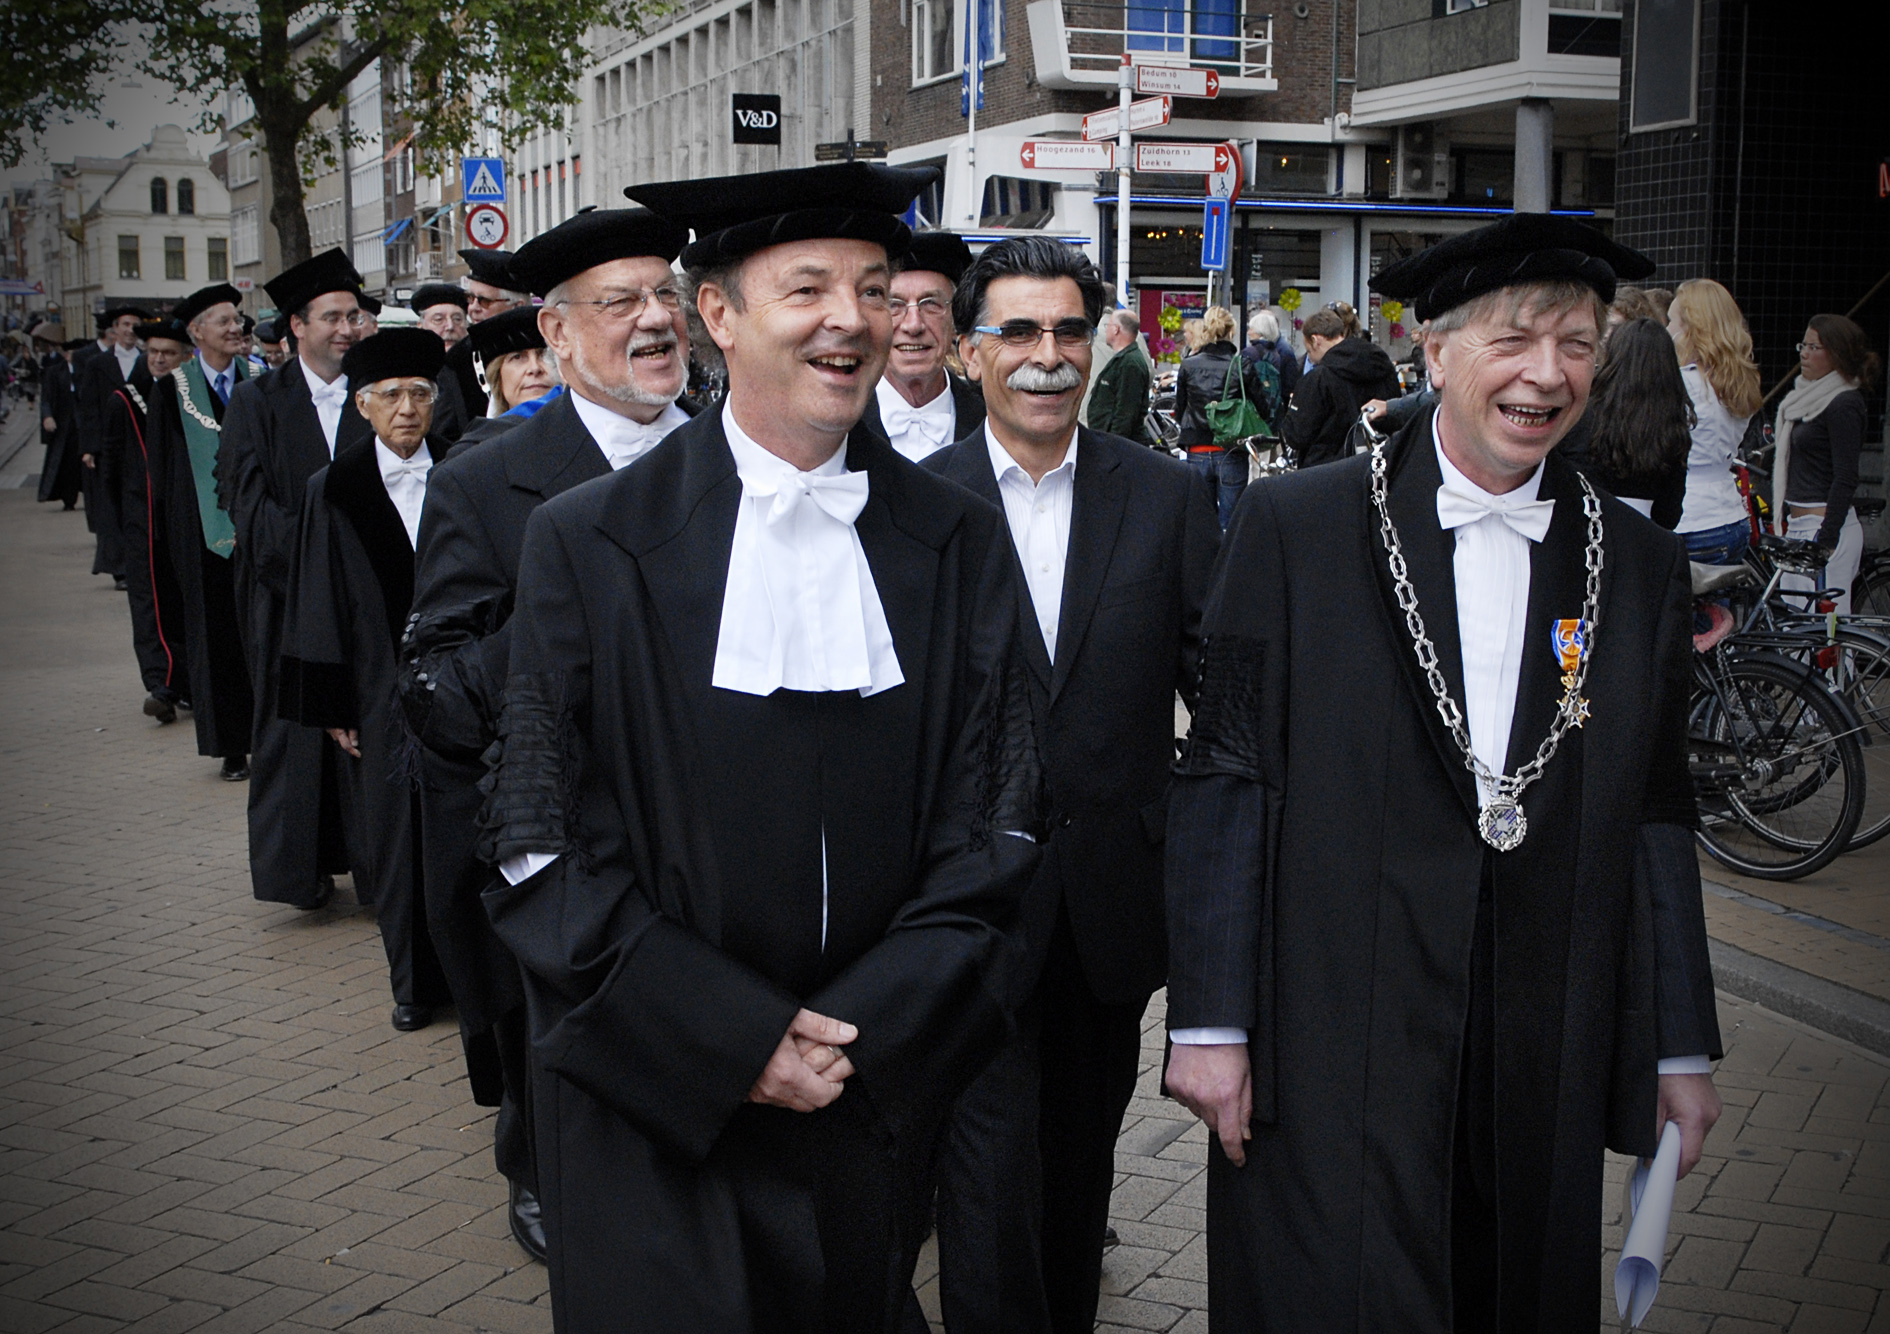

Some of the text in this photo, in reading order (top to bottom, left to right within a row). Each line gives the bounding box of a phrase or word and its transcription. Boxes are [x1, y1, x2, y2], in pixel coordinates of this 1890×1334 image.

[1141, 69, 1167, 78] Bedum
[1141, 81, 1171, 90] Winsum
[735, 109, 778, 128] V&D
[1036, 145, 1085, 155] Hoogezand
[1141, 147, 1180, 155] Zuidhorn
[1141, 159, 1160, 167] Leek
